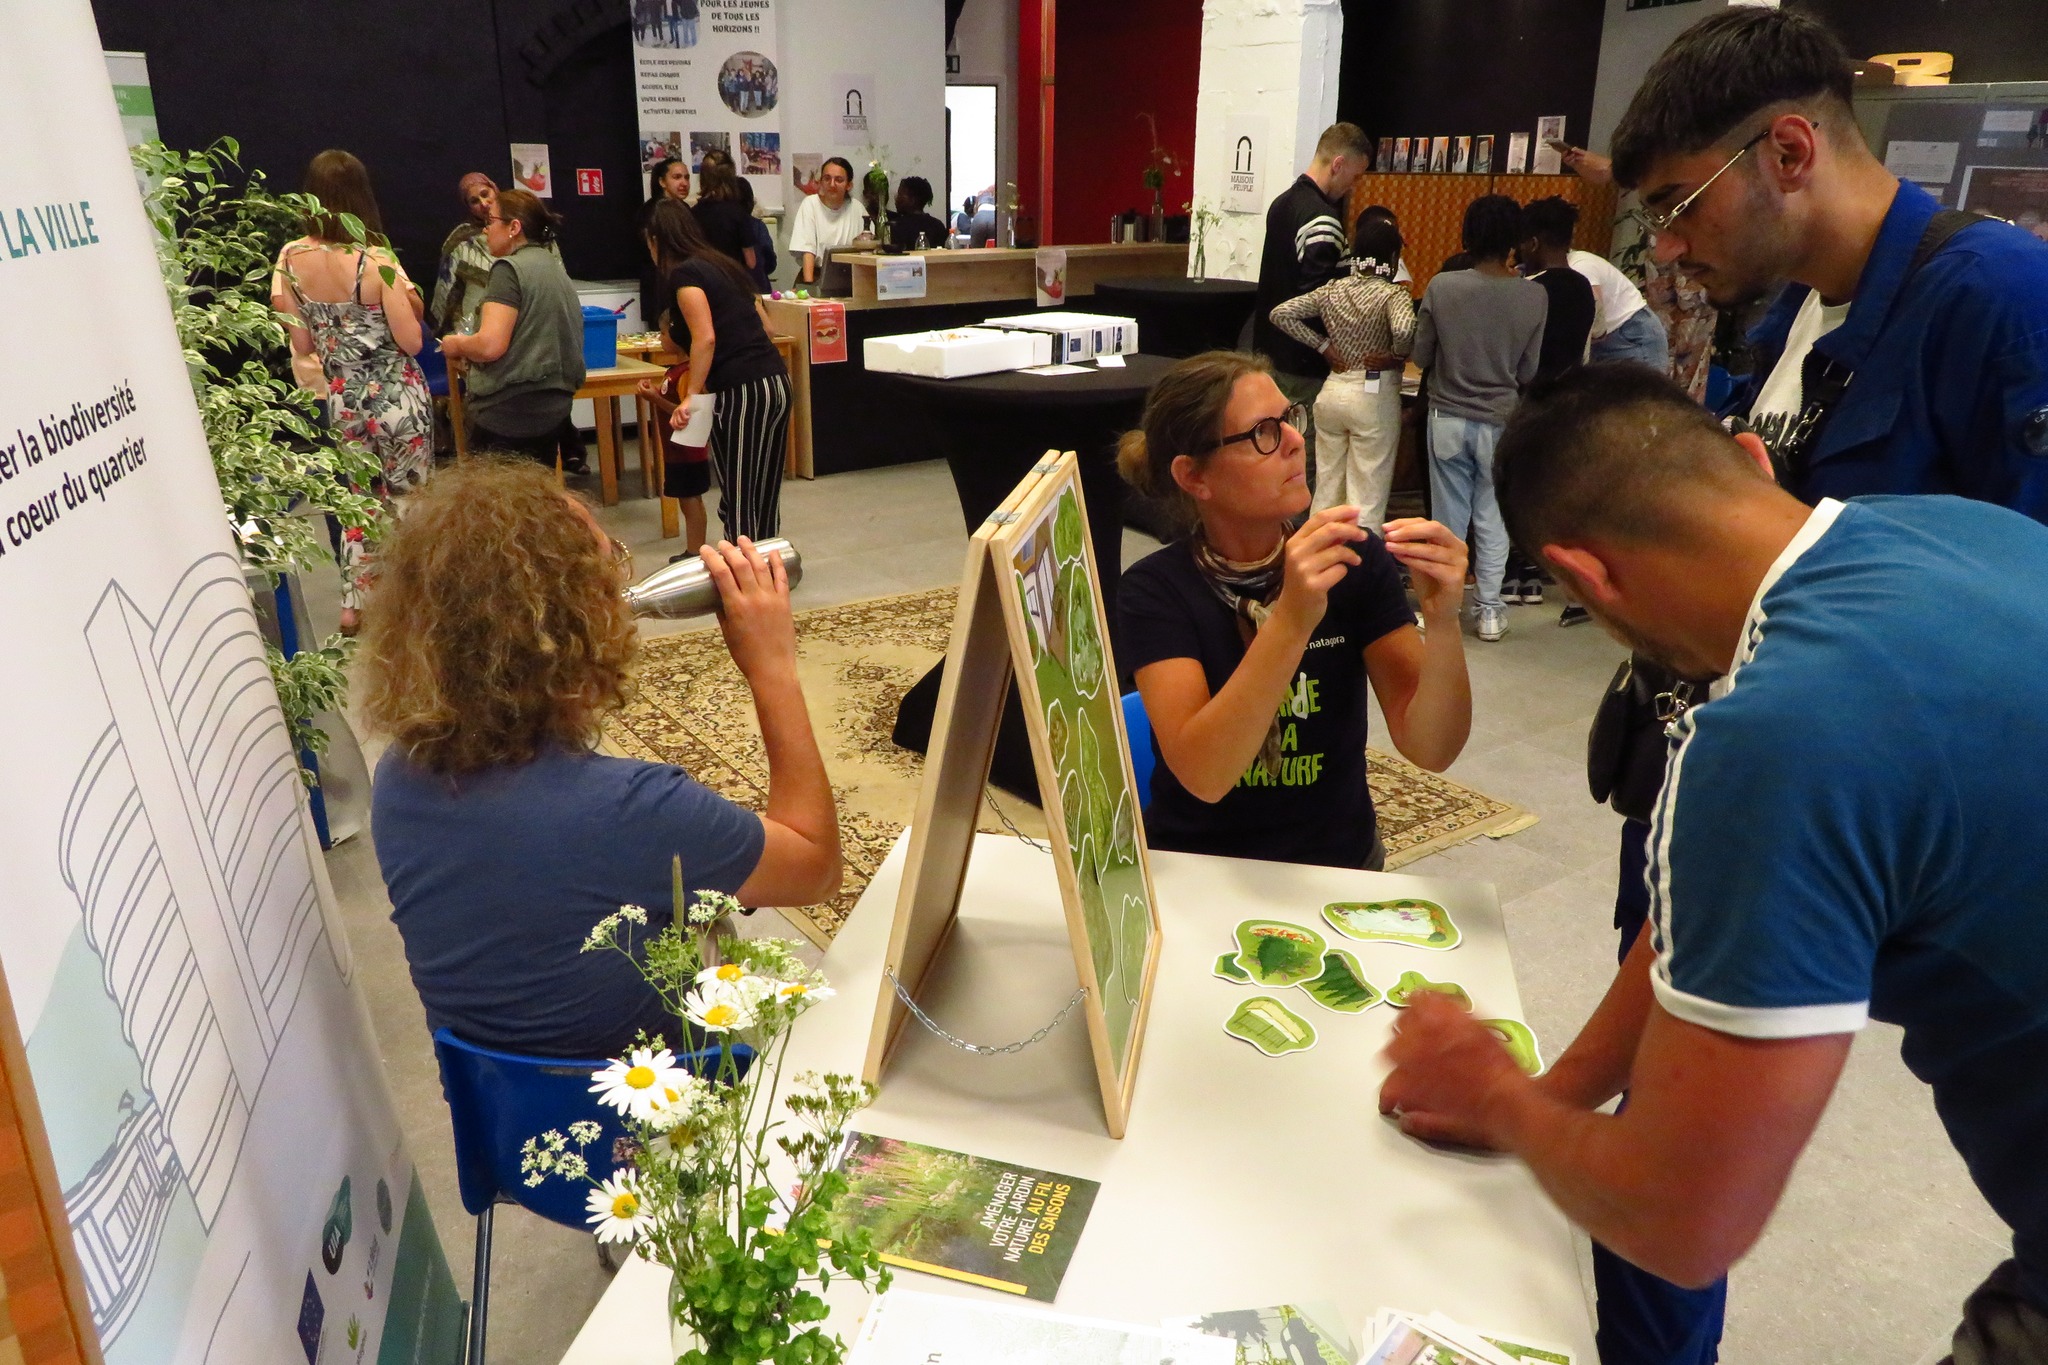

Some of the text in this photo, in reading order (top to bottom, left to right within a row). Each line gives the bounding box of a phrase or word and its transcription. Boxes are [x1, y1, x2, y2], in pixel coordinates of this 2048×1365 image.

[711, 12, 760, 21] DE TOUS LES
[712, 25, 753, 33] HORIZONS
[723, 0, 738, 8] LES
[1230, 175, 1254, 184] MAISON
[0, 201, 99, 259] LA VILLE
[0, 378, 137, 484] er la biodiversité
[6, 437, 147, 547] coeur du quartier
[1309, 635, 1345, 650] natagora
[1236, 753, 1324, 788] NAURE
[980, 1172, 1019, 1229] AMÉNAGER
[989, 1175, 1036, 1247] VOTRE JARDIN
[1003, 1181, 1053, 1263] NATUREL AU FIL
[1028, 1183, 1071, 1255] DES SAISONS
